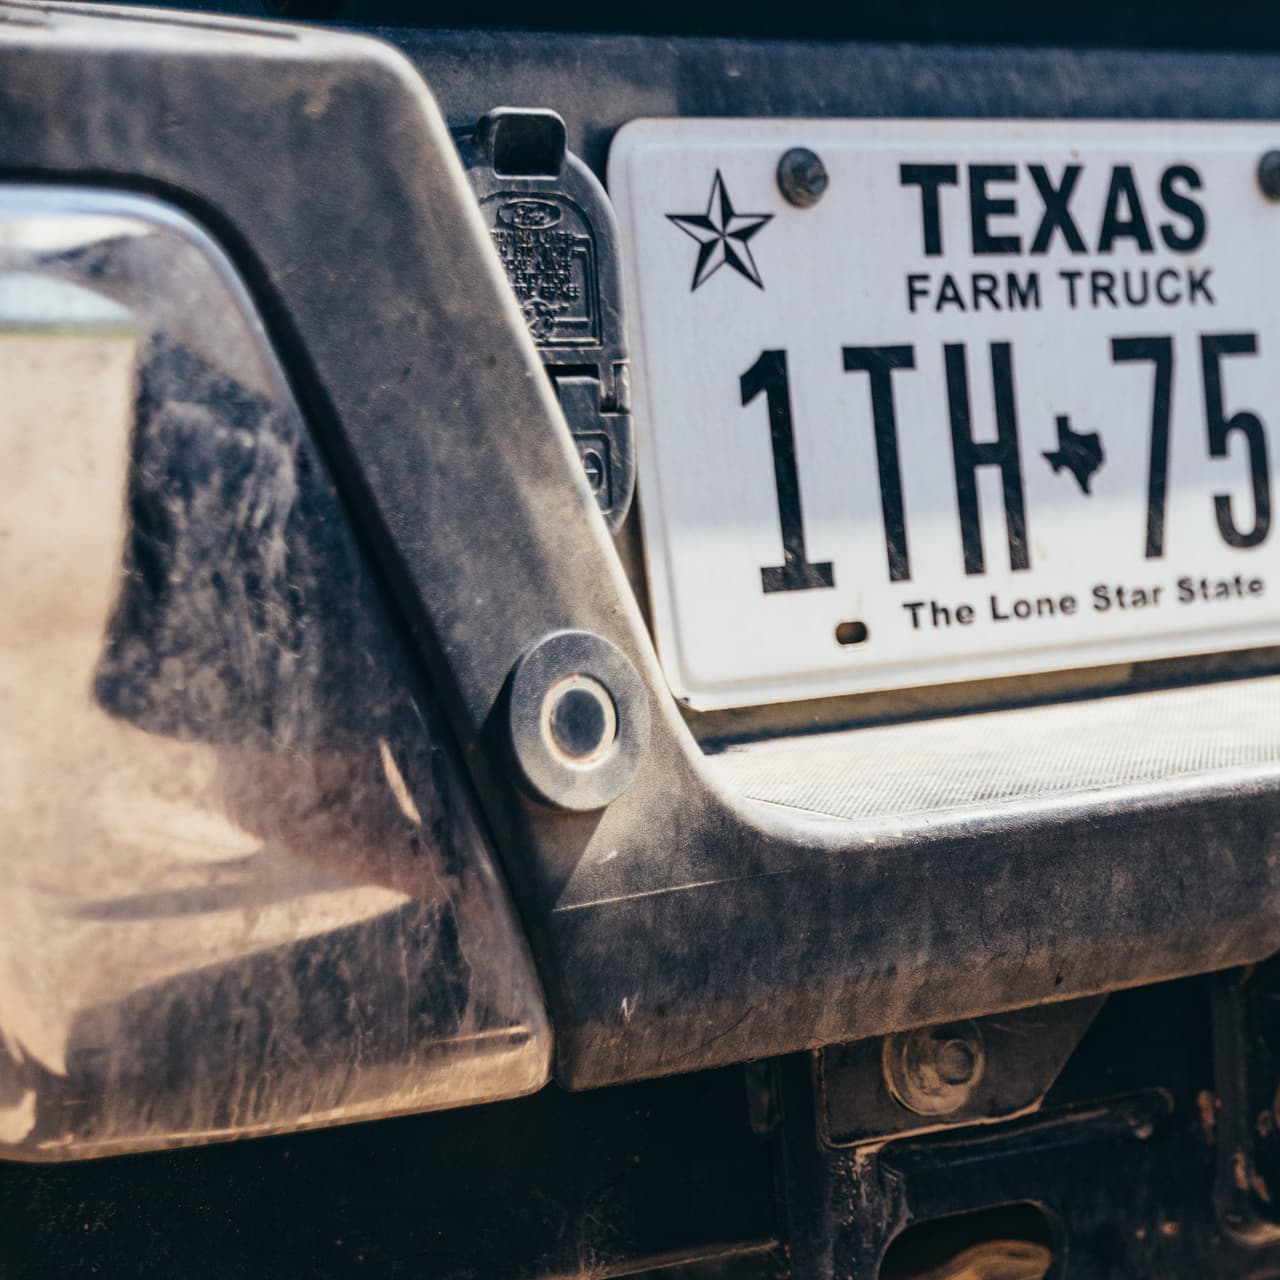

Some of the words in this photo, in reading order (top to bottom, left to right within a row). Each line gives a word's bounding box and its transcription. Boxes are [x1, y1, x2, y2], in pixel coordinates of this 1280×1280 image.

[899, 163, 1208, 257] TEXAS
[906, 272, 1042, 312] FARM
[1059, 268, 1217, 309] TRUCK
[903, 601, 975, 629] The
[991, 595, 1077, 621] Lone
[1092, 583, 1165, 612] Star
[1176, 574, 1266, 603] State
